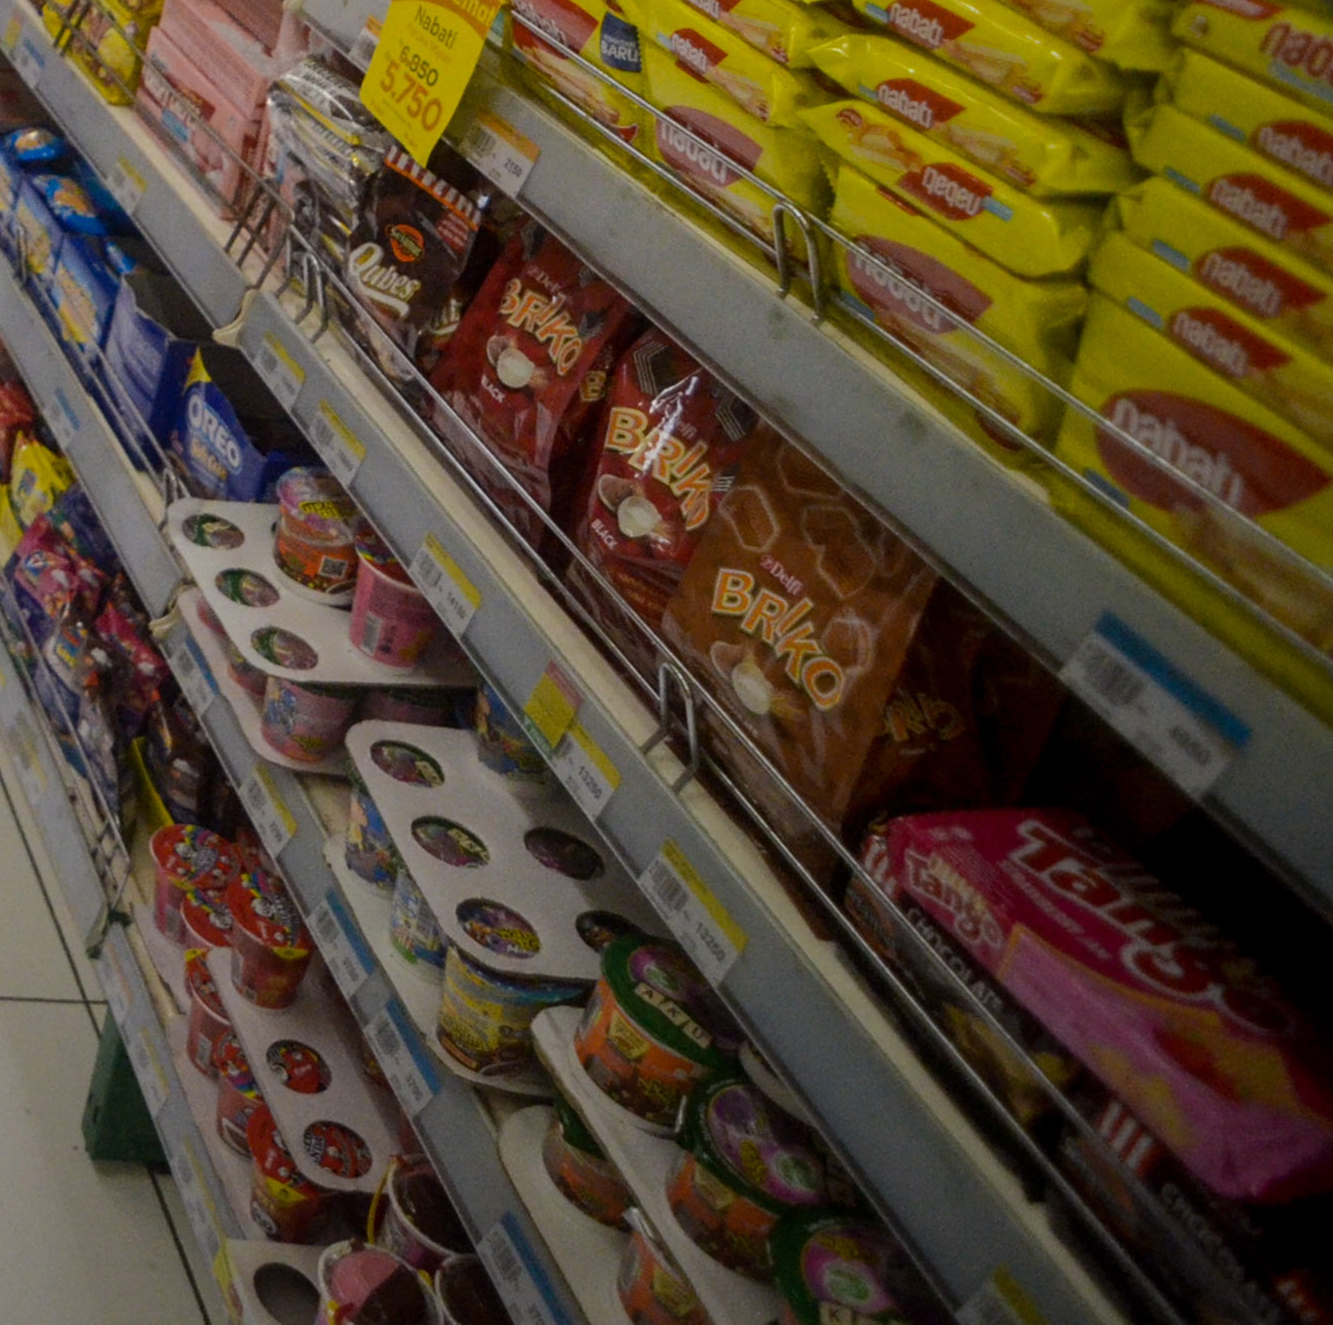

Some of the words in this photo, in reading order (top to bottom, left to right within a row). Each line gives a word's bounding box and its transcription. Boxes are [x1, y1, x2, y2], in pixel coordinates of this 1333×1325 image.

[415, 3, 459, 51] Nabati
[887, 1, 945, 51] nabati
[379, 60, 445, 133] 5.750
[877, 82, 935, 129] nabati
[499, 278, 584, 376] BRIKO
[189, 399, 243, 476] OREO
[605, 405, 711, 531] BRIKO
[589, 516, 618, 551] BLACK
[711, 566, 847, 711] BRIKO
